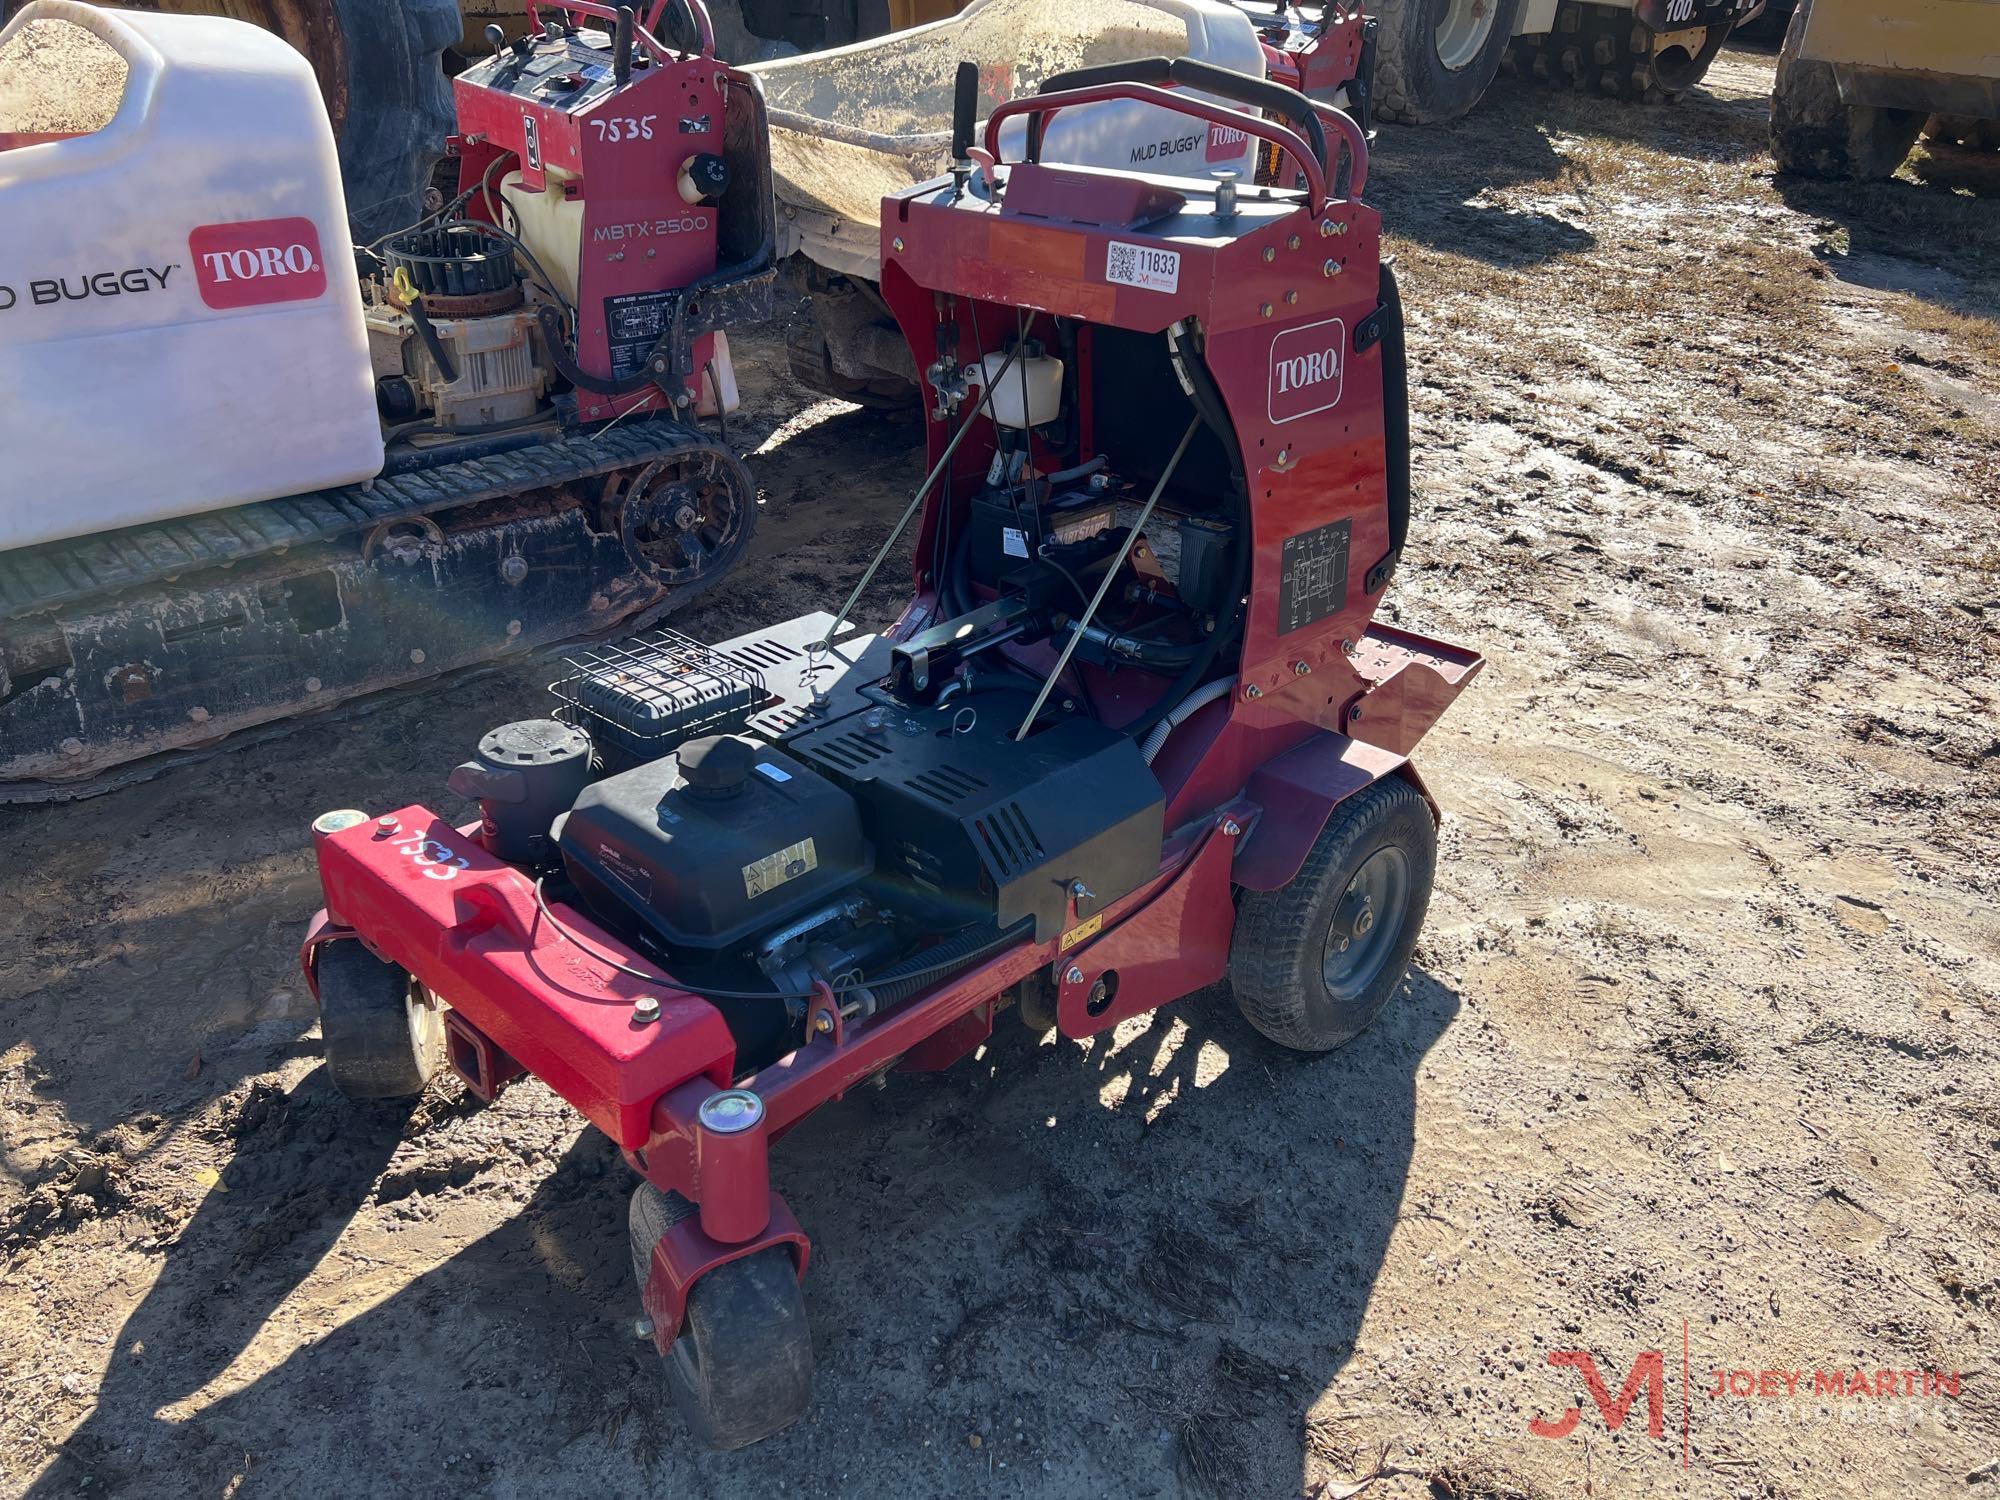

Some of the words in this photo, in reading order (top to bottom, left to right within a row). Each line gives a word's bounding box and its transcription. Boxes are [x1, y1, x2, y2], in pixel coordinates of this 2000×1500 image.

[590, 115, 657, 142] 7535
[1130, 144, 1157, 163] MUD
[1140, 250, 1176, 275] 11833
